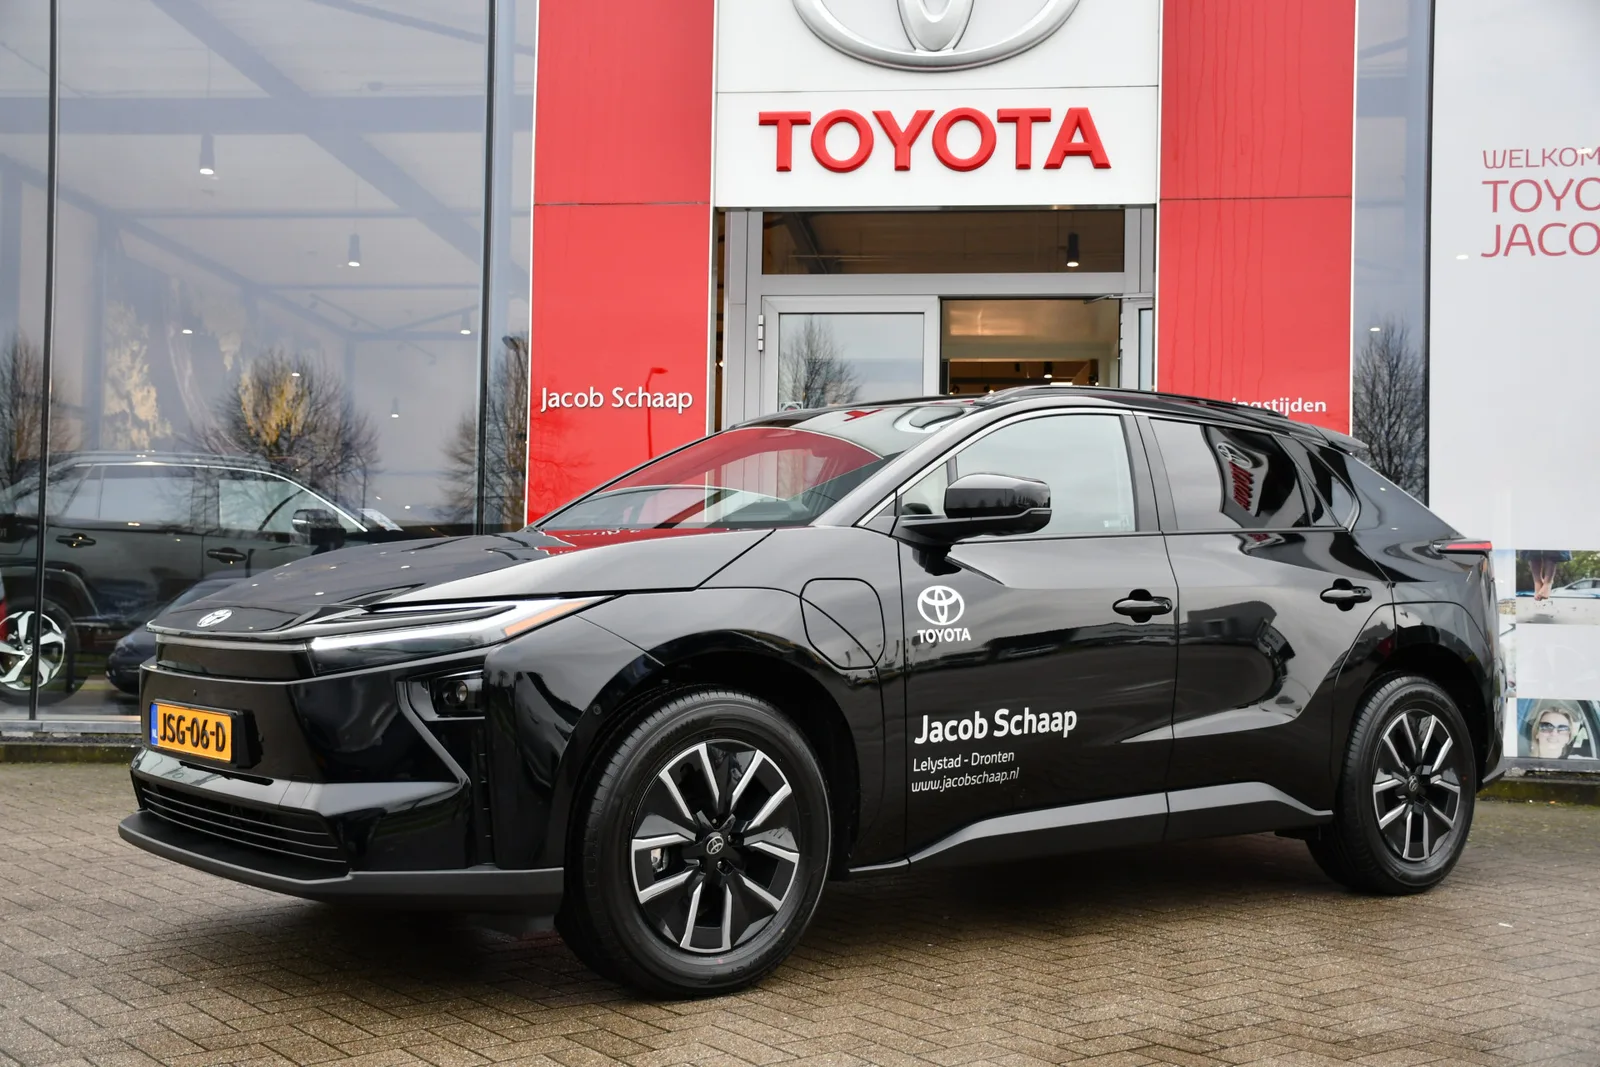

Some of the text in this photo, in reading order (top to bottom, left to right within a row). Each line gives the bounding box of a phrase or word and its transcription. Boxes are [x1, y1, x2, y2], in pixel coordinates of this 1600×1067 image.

[758, 107, 1111, 173] TOYOTA
[1483, 146, 1600, 169] WELKOM
[1482, 177, 1600, 213] TOYO
[1481, 222, 1600, 258] JACO
[541, 386, 693, 414] Jacob Schaap
[916, 627, 972, 644] TOYOTA
[160, 713, 226, 752] JSG-06-D
[914, 706, 1078, 745] Jacob Schaap
[913, 754, 962, 774] Lelystad
[971, 751, 1015, 766] Dronten
[911, 766, 1020, 793] www.jacobschaap.nl
